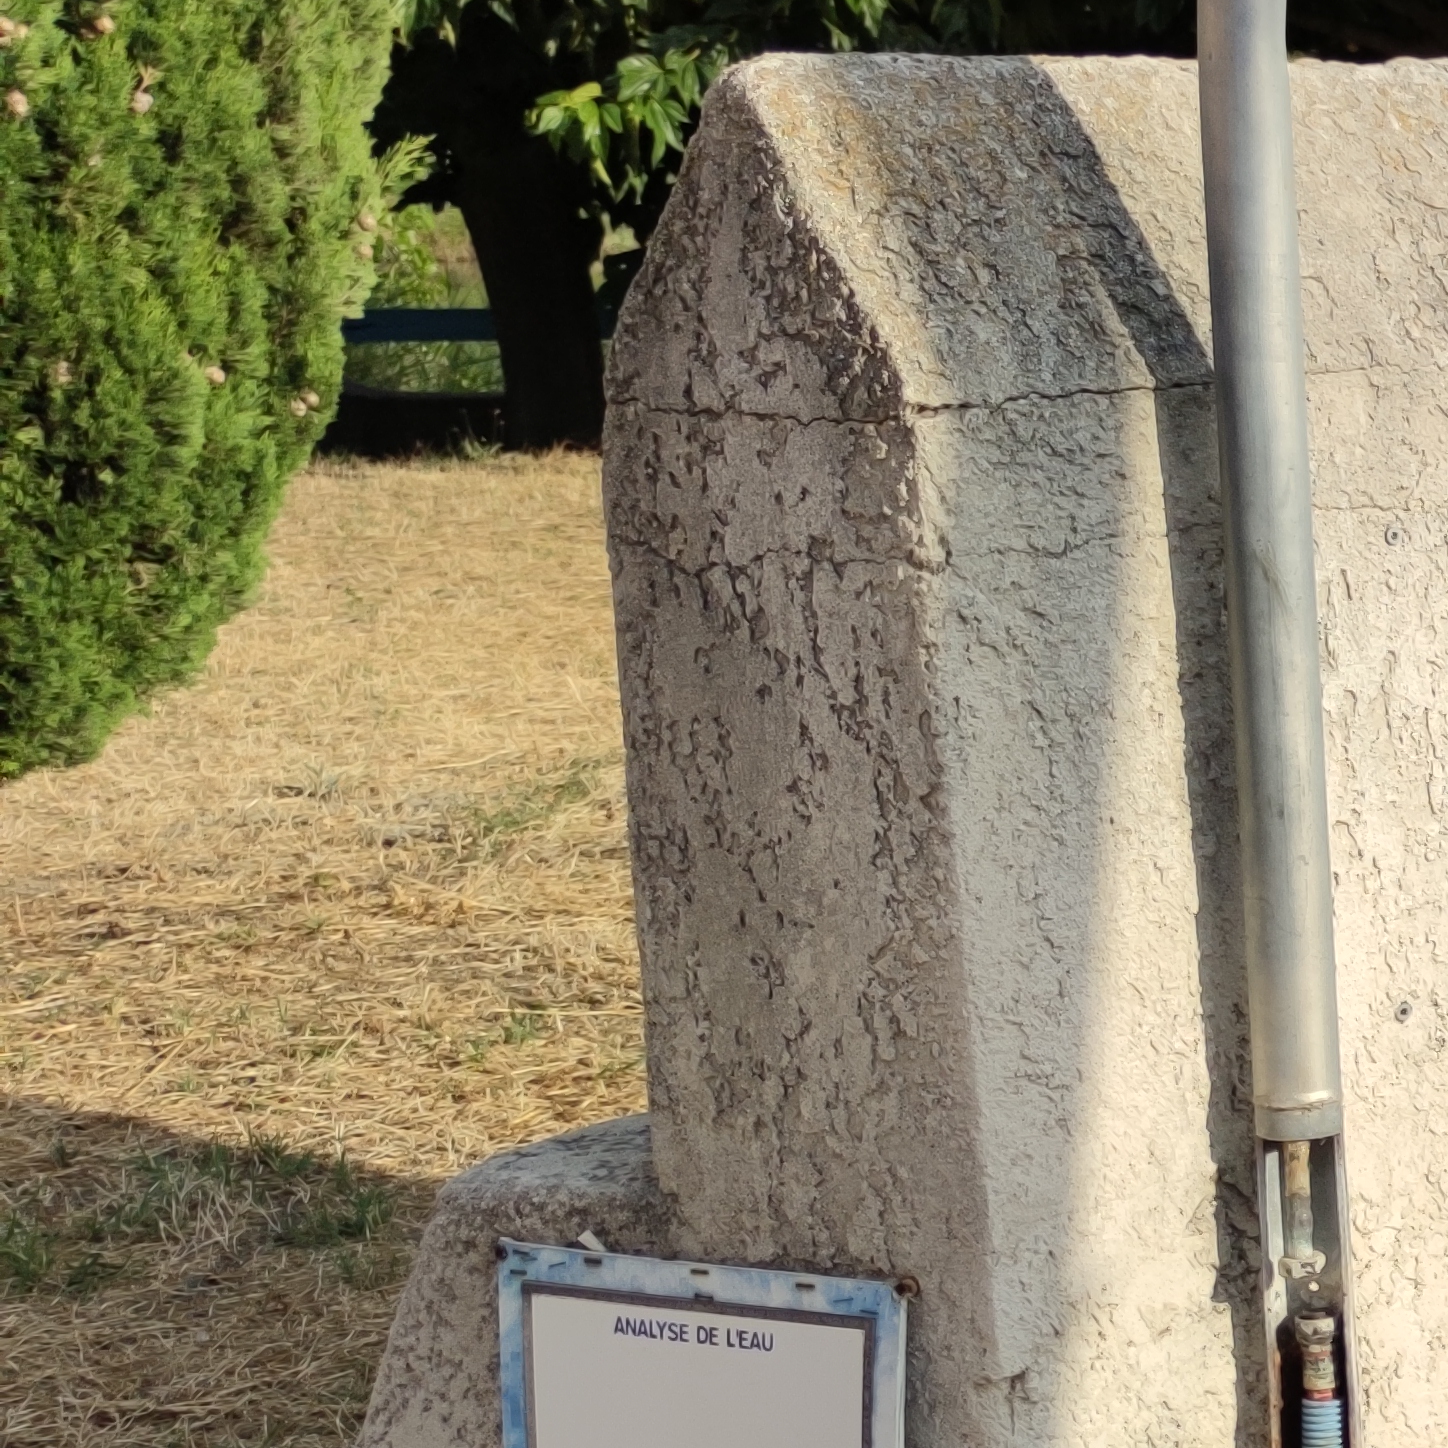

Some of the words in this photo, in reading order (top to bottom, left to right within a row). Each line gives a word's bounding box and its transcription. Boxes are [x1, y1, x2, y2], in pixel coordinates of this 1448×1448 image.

[613, 1316, 690, 1343] ANALYSE
[696, 1324, 719, 1347] DE
[726, 1327, 775, 1353] L'EAU
